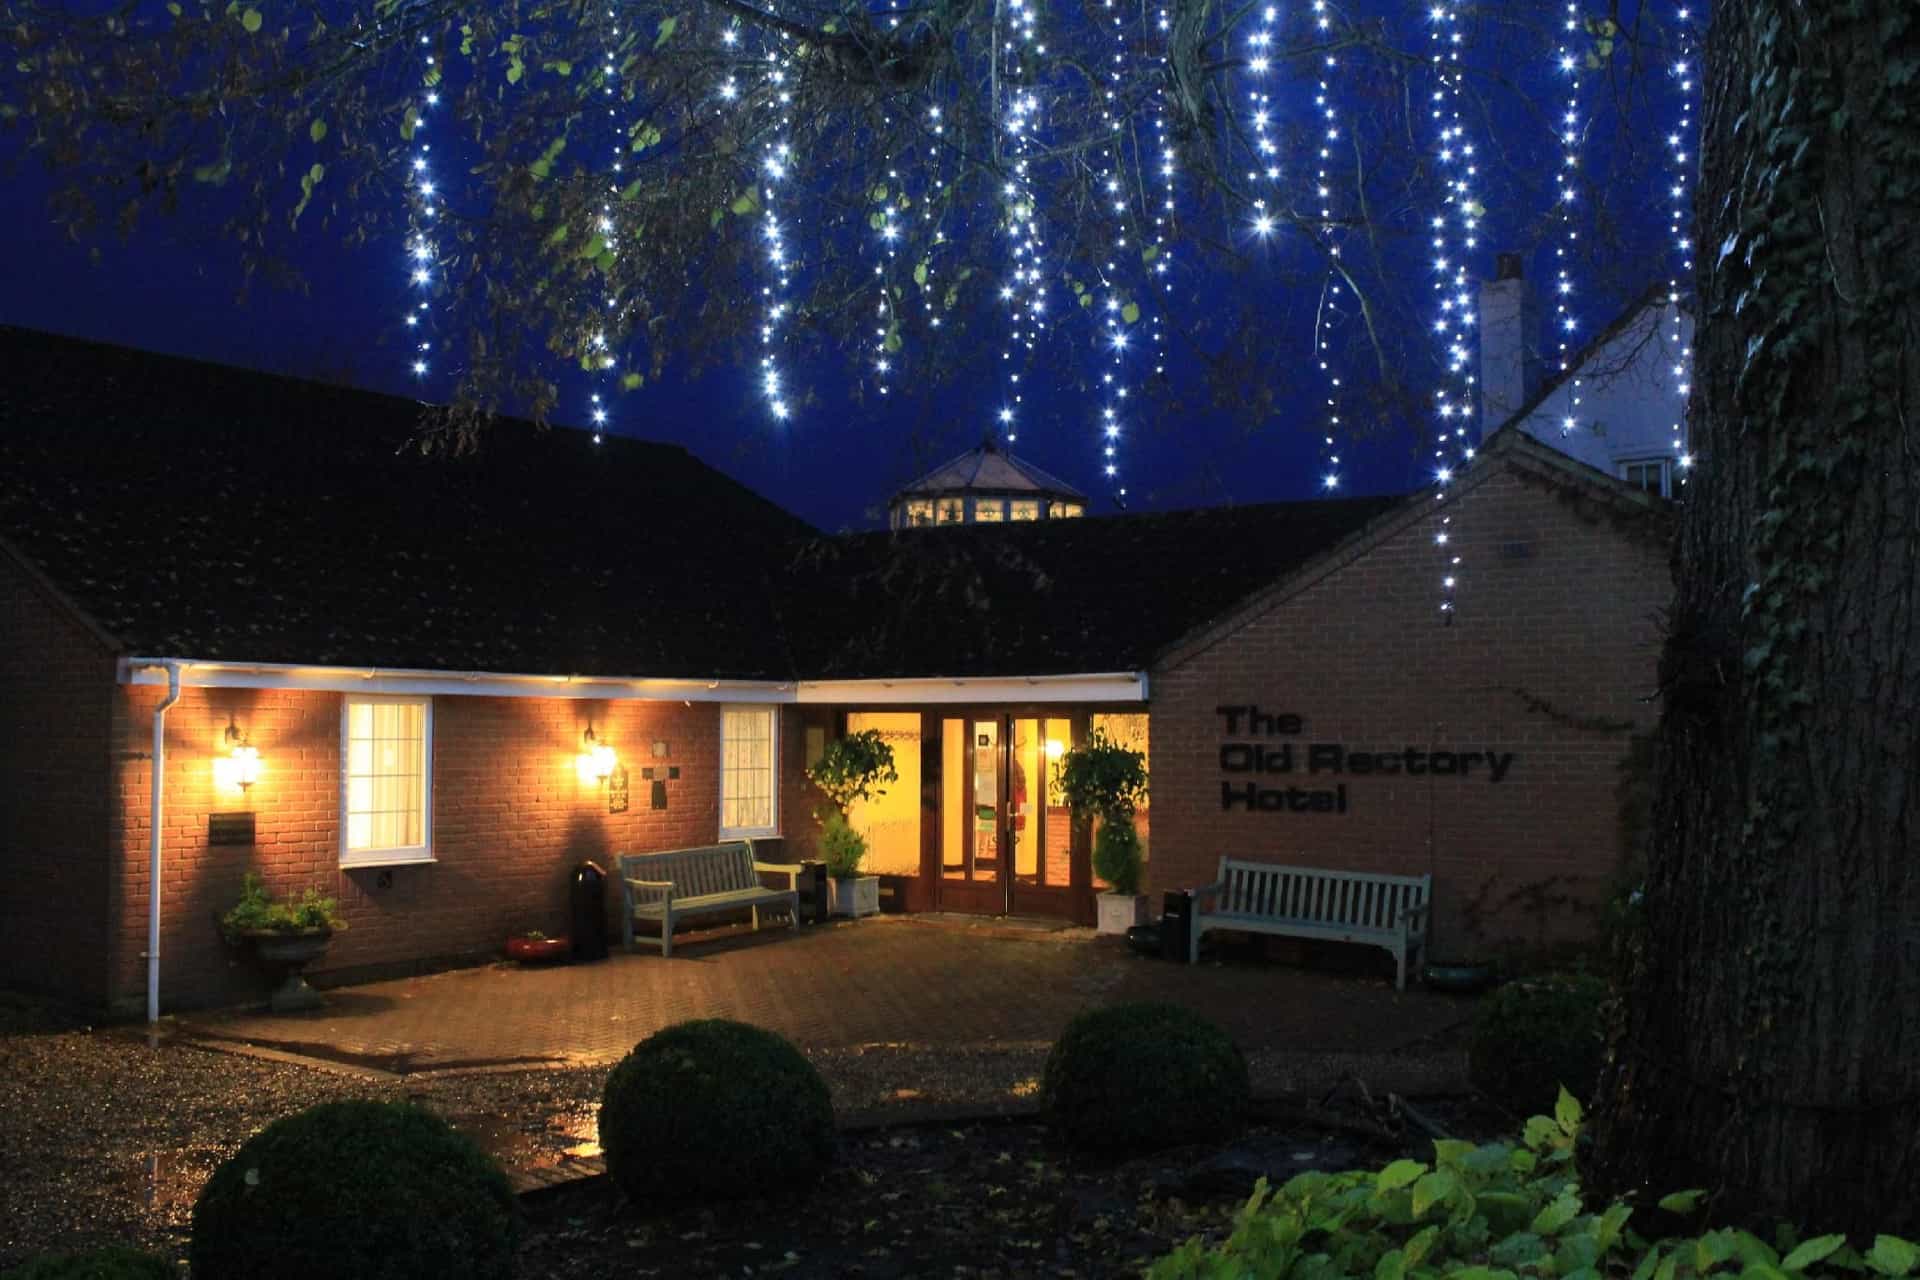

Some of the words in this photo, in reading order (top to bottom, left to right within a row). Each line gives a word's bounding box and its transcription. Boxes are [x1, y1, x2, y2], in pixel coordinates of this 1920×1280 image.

[1216, 705, 1303, 735] The
[1219, 744, 1292, 773] Old
[1308, 744, 1513, 782] Rectory
[1221, 782, 1347, 813] Hotel
